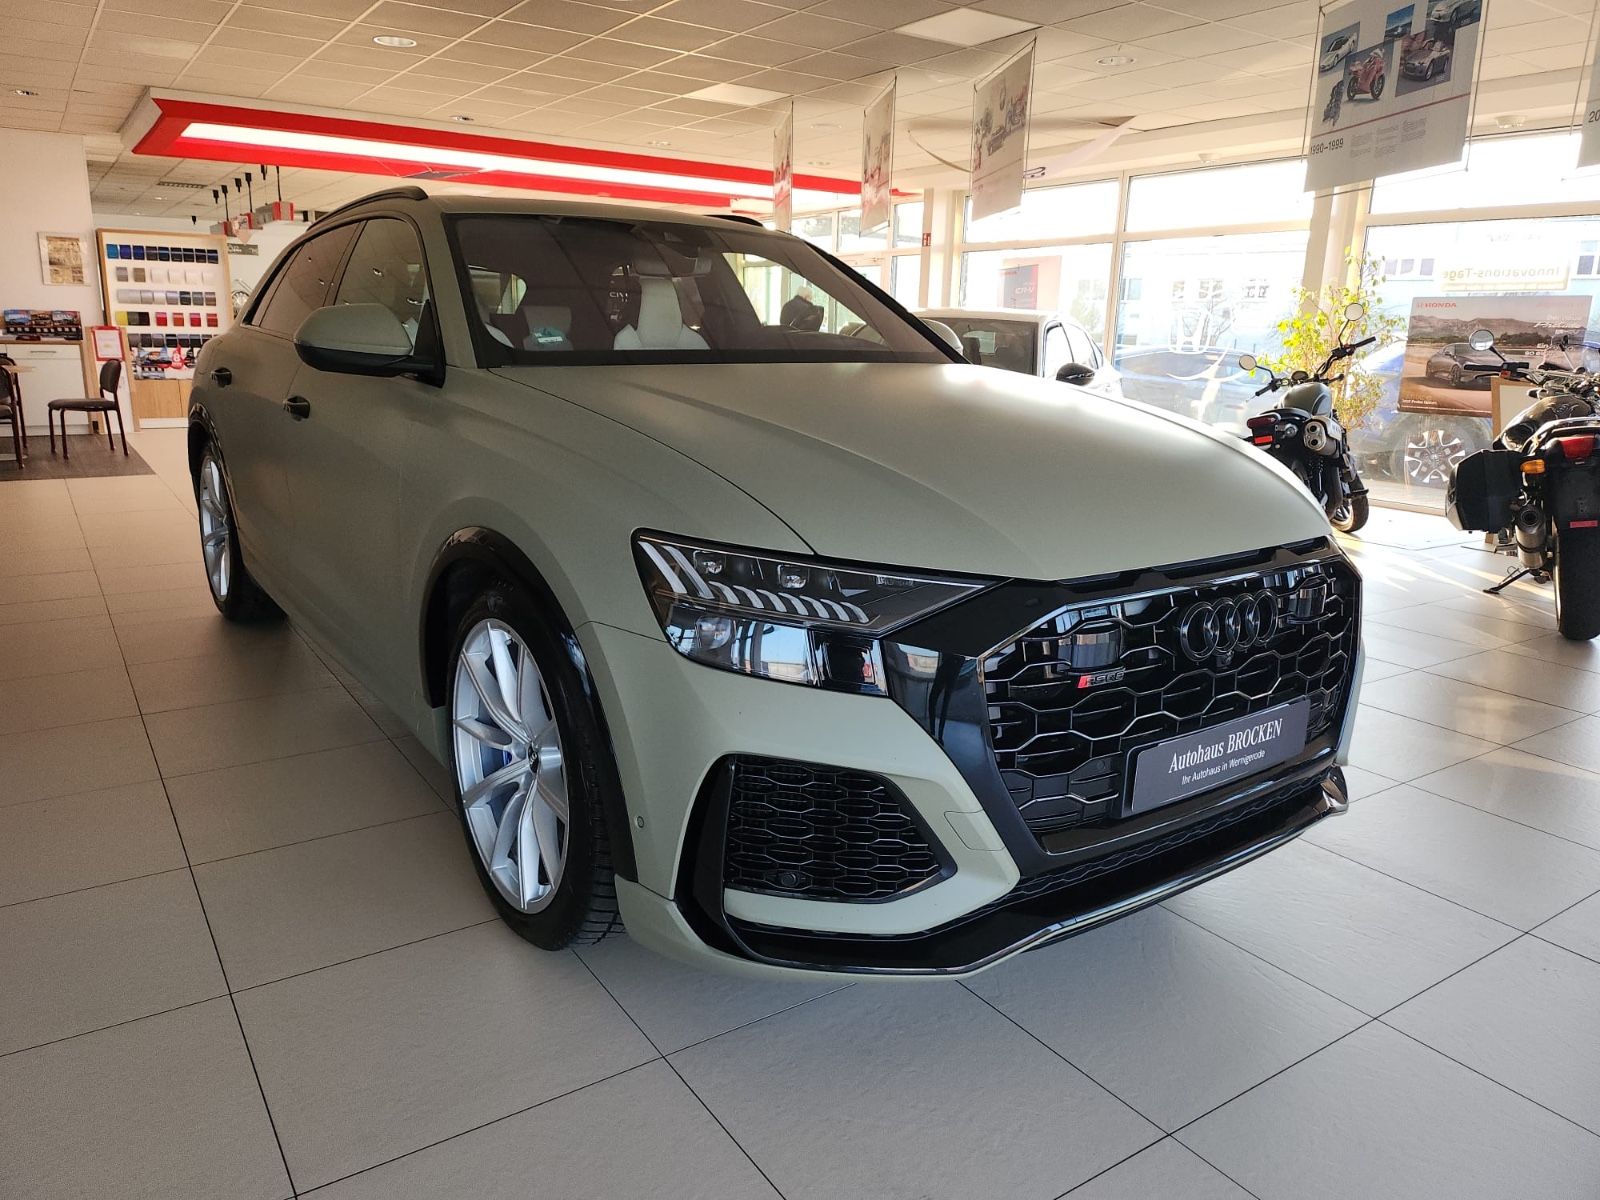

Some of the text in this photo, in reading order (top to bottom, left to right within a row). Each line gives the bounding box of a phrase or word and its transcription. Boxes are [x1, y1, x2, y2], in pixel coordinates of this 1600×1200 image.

[1168, 718, 1283, 774] Autohaus BROCKEN
[1182, 775, 1192, 785] Ihr
[1191, 765, 1221, 782] Autohaus
[1221, 762, 1228, 771] in
